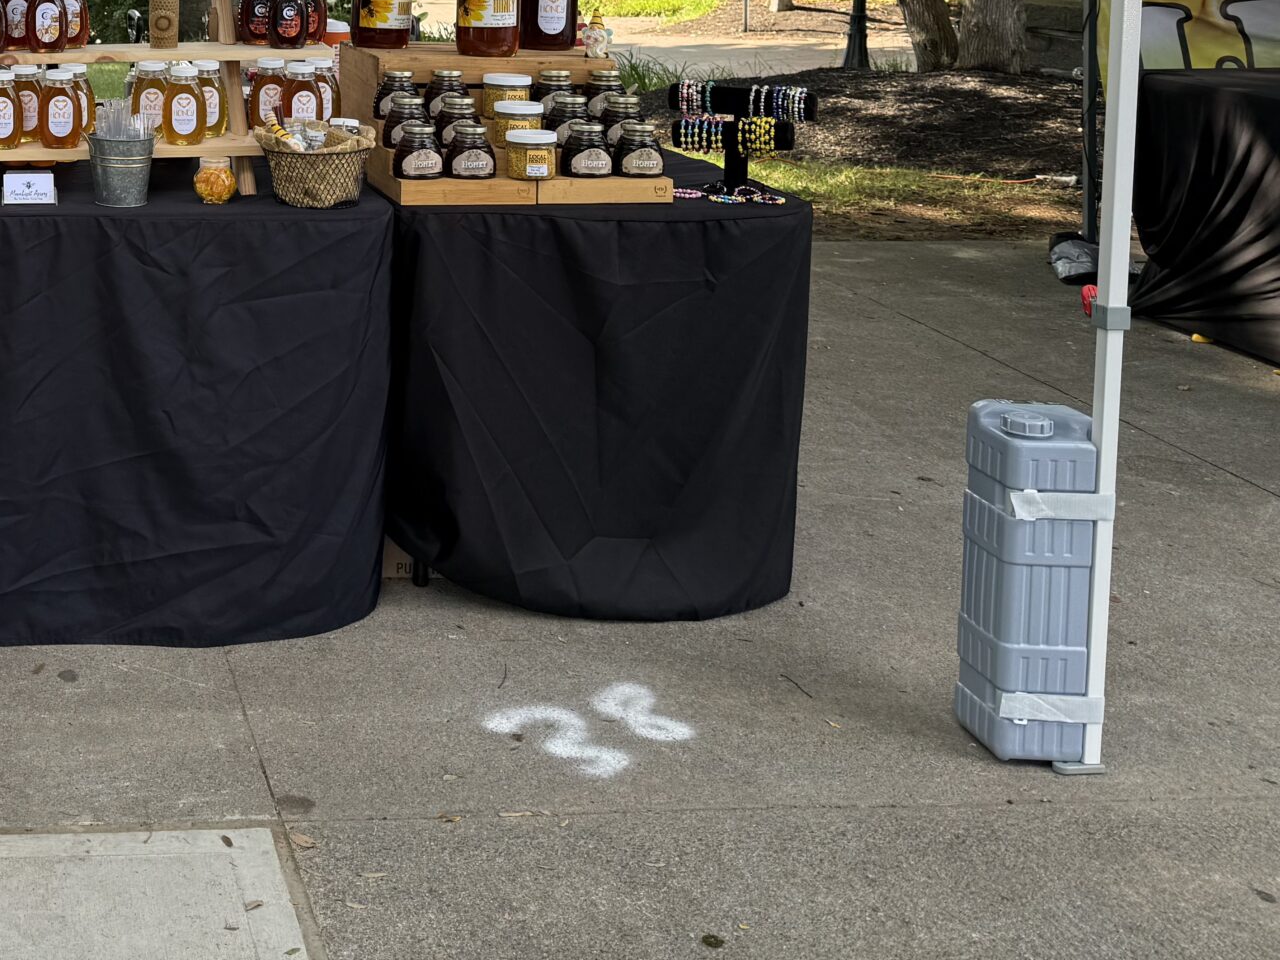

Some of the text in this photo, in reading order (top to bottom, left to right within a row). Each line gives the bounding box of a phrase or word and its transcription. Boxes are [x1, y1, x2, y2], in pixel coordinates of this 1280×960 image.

[540, 4, 566, 13] HONEY
[413, 160, 436, 168] HONEY
[462, 160, 487, 168] HONEY
